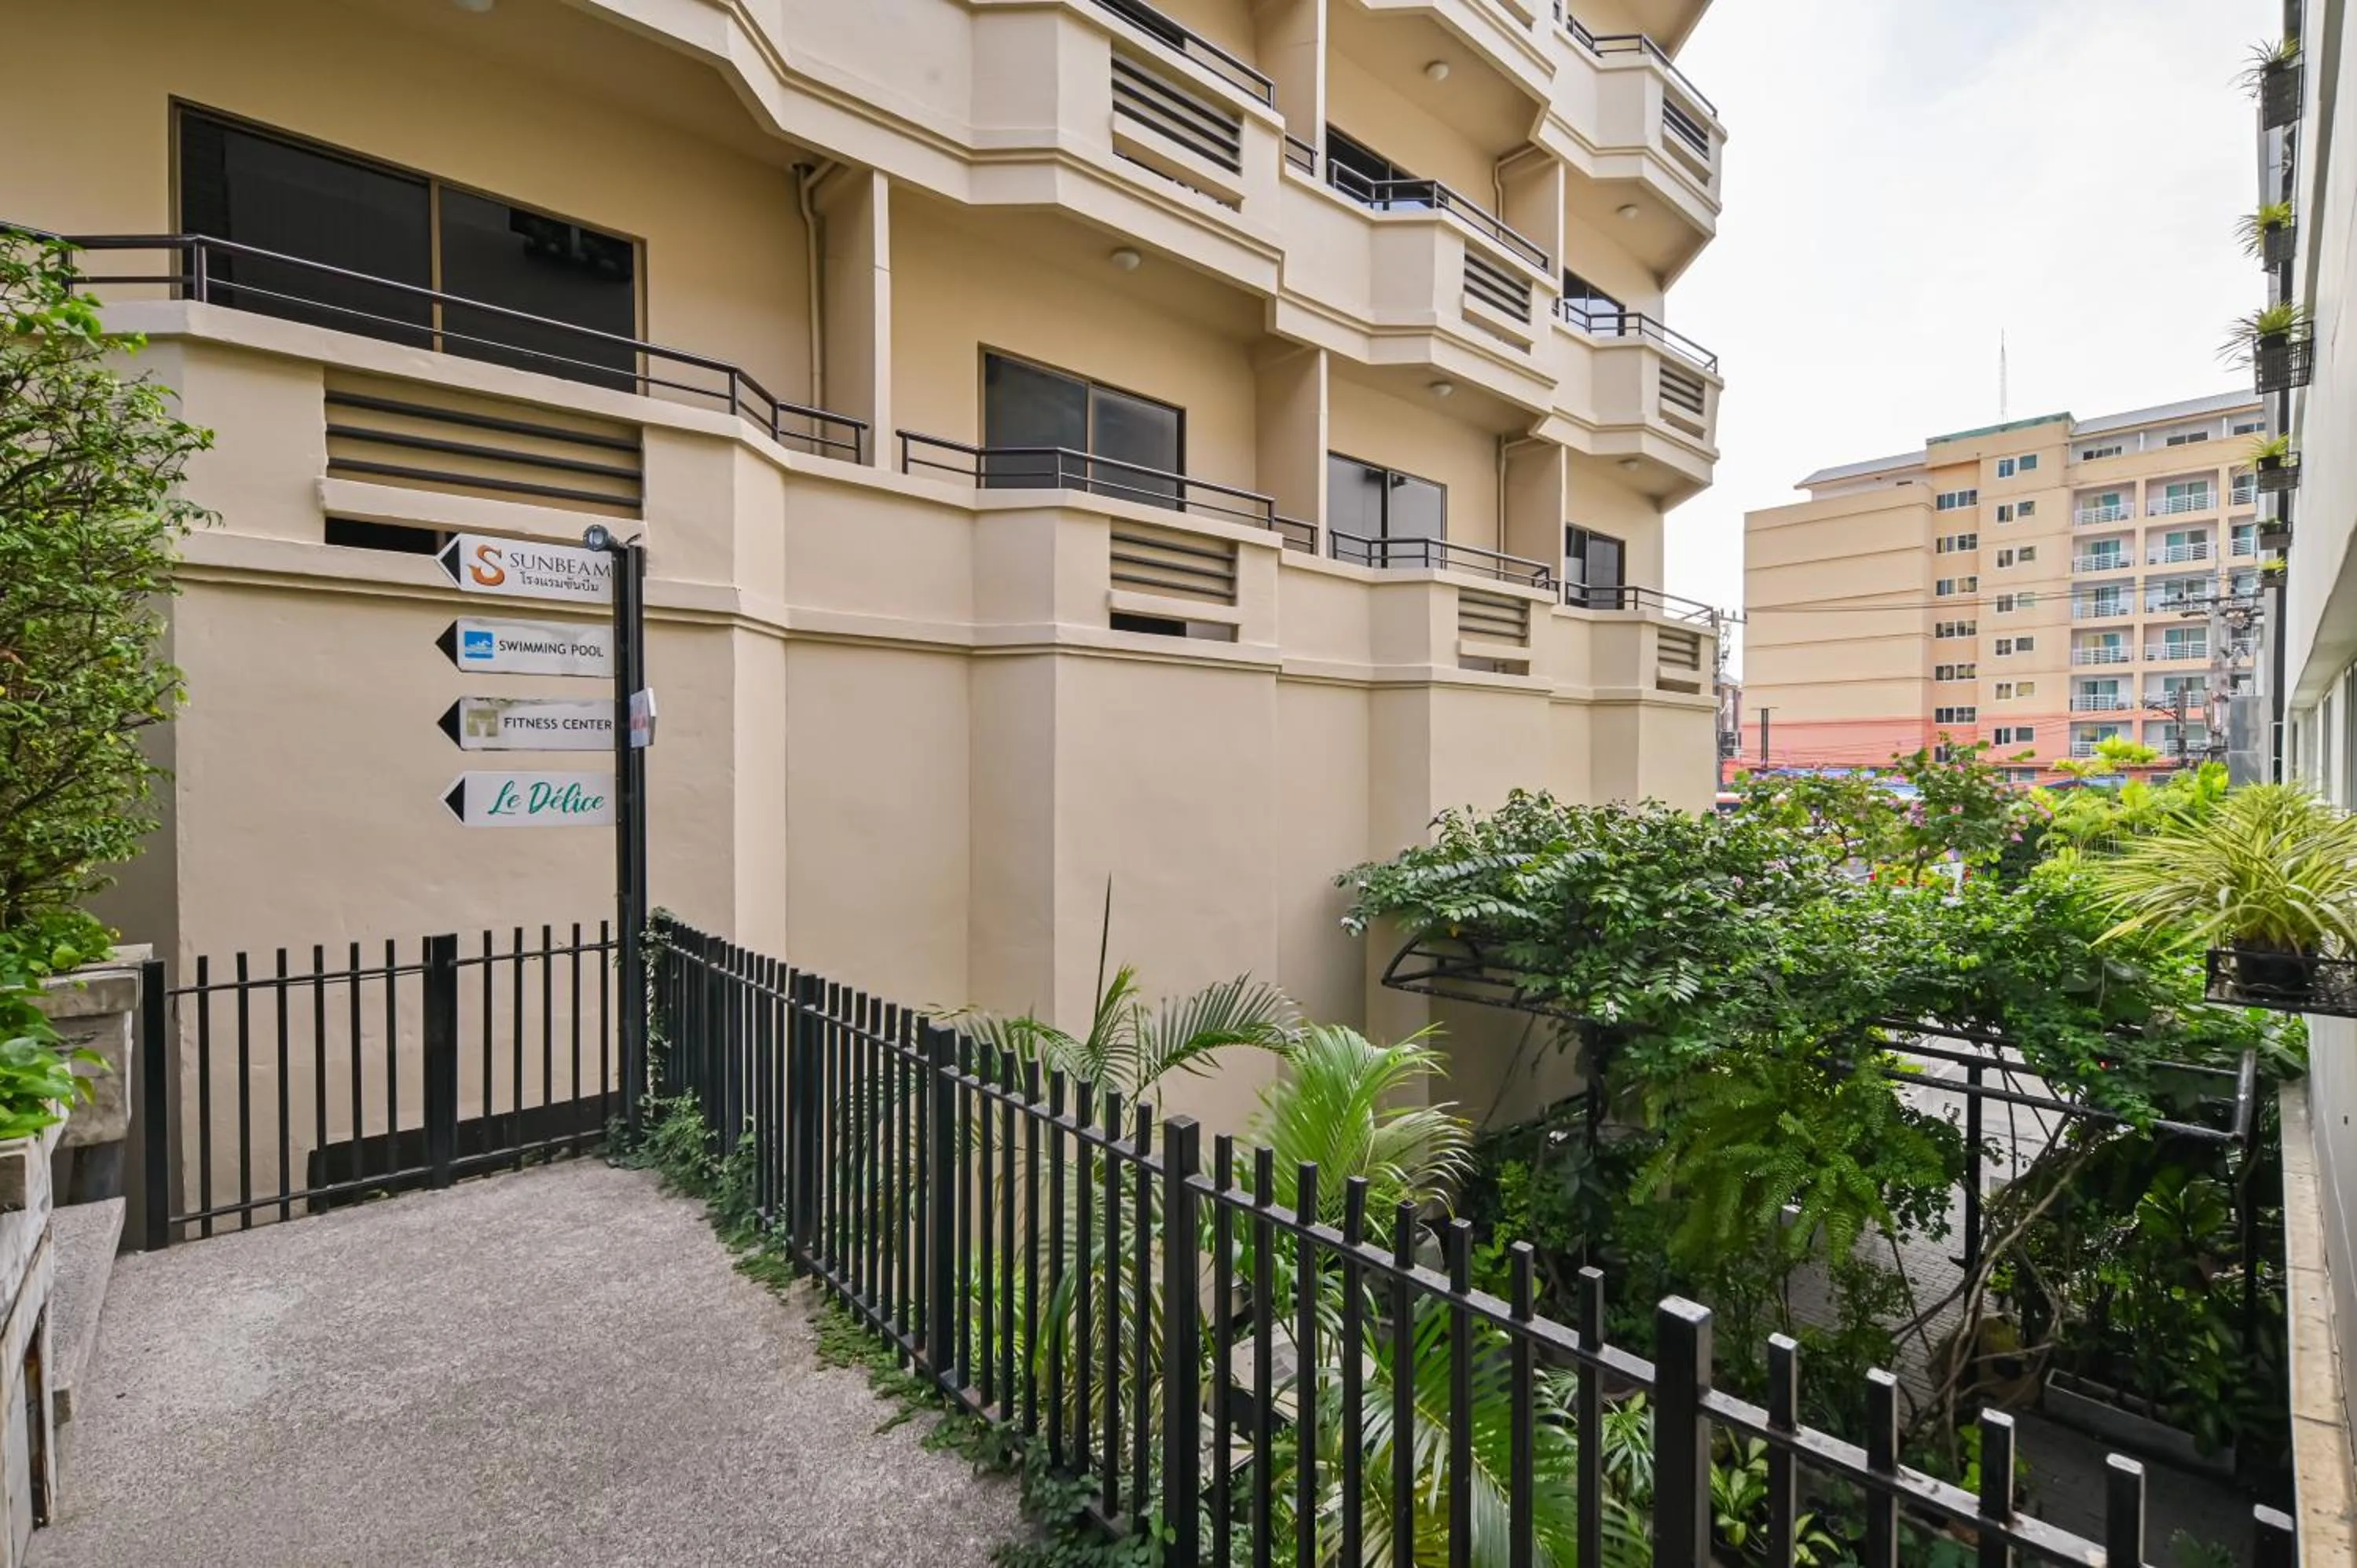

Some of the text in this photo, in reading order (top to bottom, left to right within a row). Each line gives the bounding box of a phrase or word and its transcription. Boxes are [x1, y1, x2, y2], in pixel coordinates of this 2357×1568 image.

[510, 552, 610, 578] SUNBEAM
[499, 640, 603, 657] SWIMMING POOL
[504, 717, 612, 730] FITNESS CENTER
[488, 781, 604, 815] Le Délice
